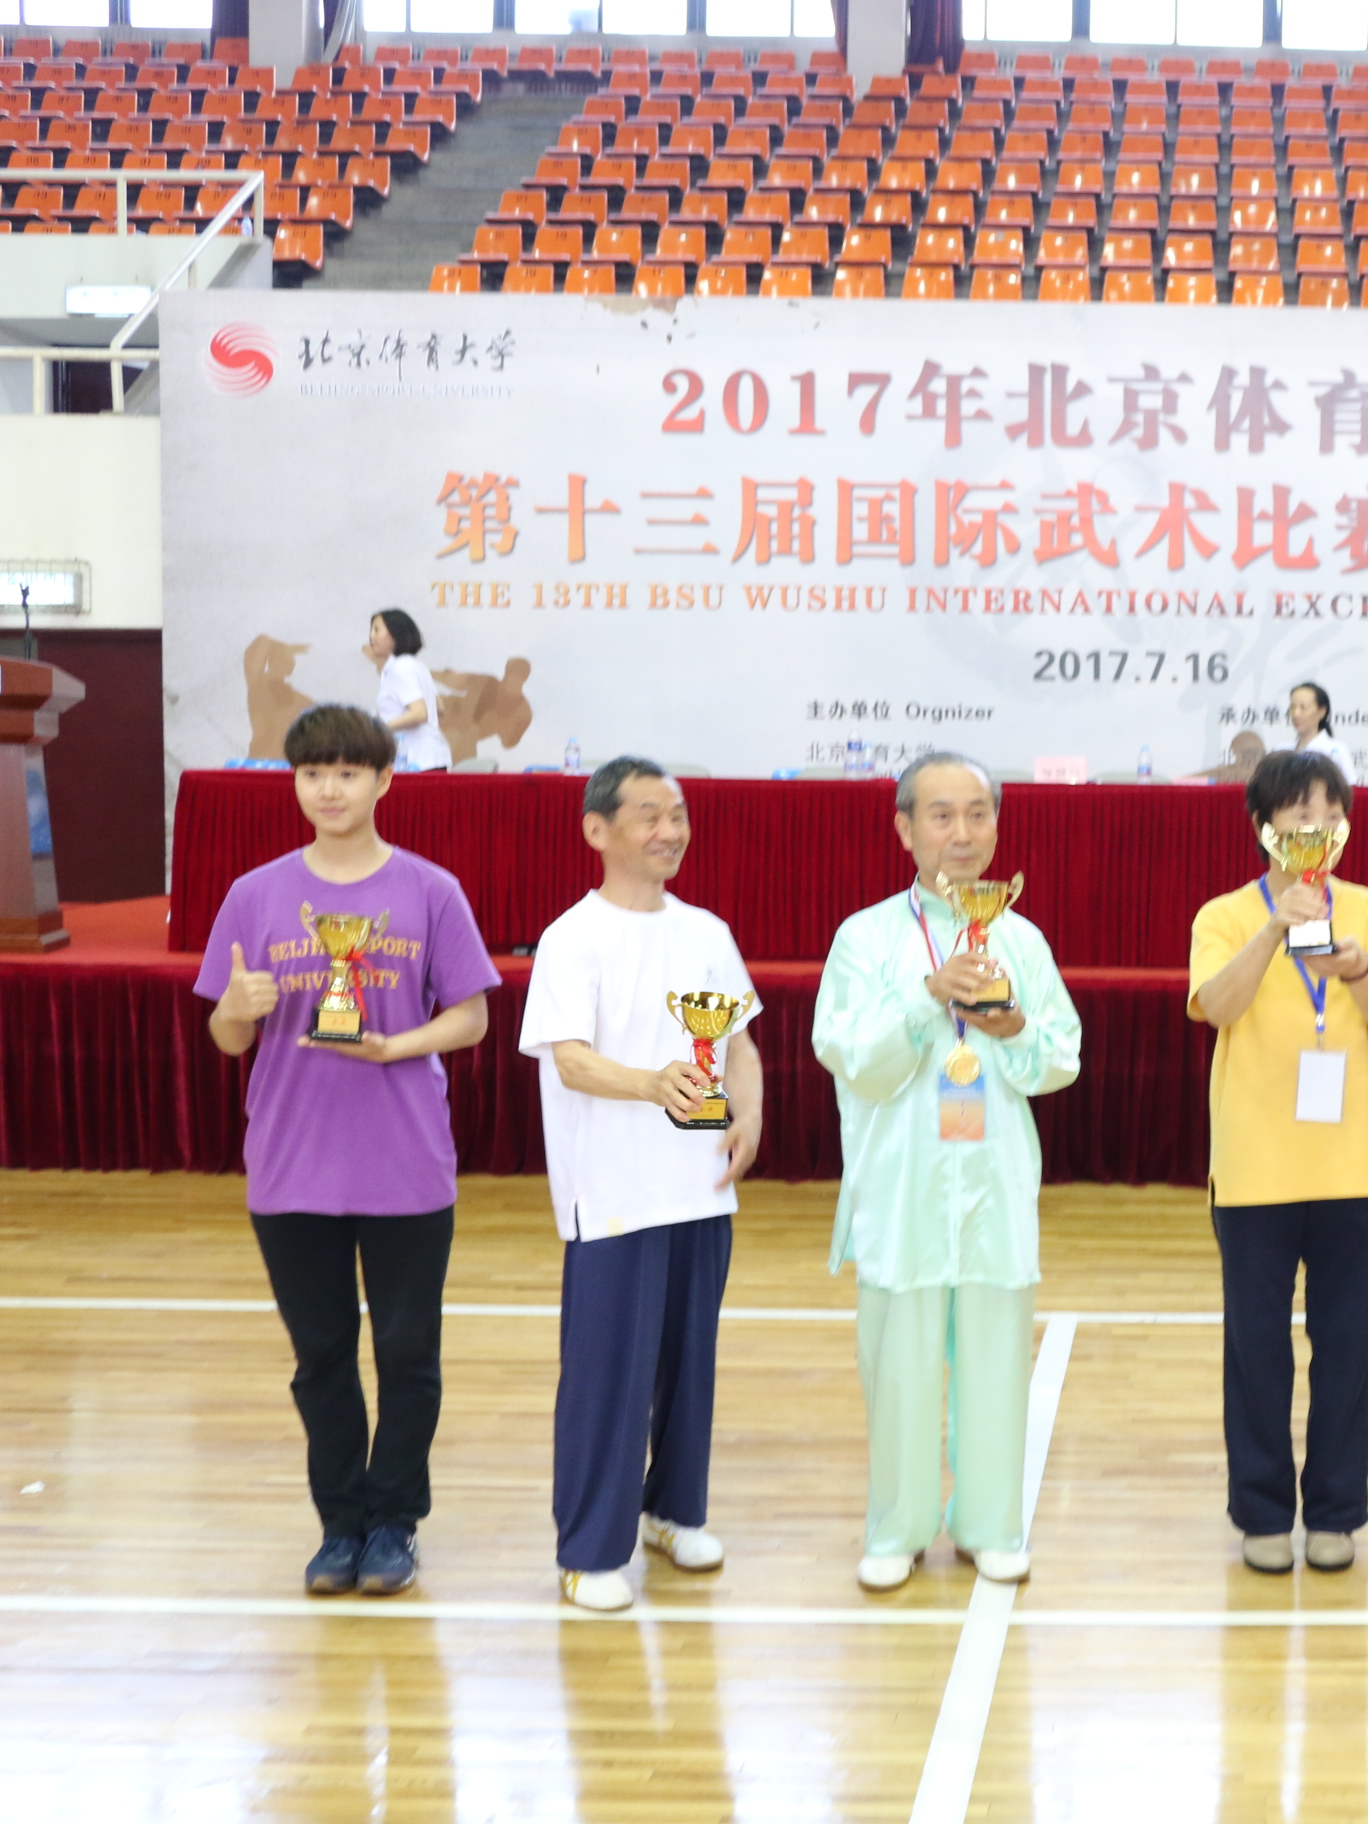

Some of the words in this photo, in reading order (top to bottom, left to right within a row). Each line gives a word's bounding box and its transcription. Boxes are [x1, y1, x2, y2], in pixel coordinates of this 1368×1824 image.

[298, 328, 516, 381] 北京体育大学
[300, 382, 361, 398] BEIJING
[421, 382, 514, 398] UNIVERSITY
[430, 581, 512, 610] THE
[532, 582, 630, 611] 13TH
[647, 583, 724, 612] BSU
[742, 583, 887, 613] WUSHU
[905, 585, 1256, 620] INTERNATIONAL
[1032, 649, 1230, 684] 2017.7.16
[806, 699, 891, 722] 主办单位
[905, 701, 995, 724] Orgnizer
[1220, 704, 1292, 726] 承办单
